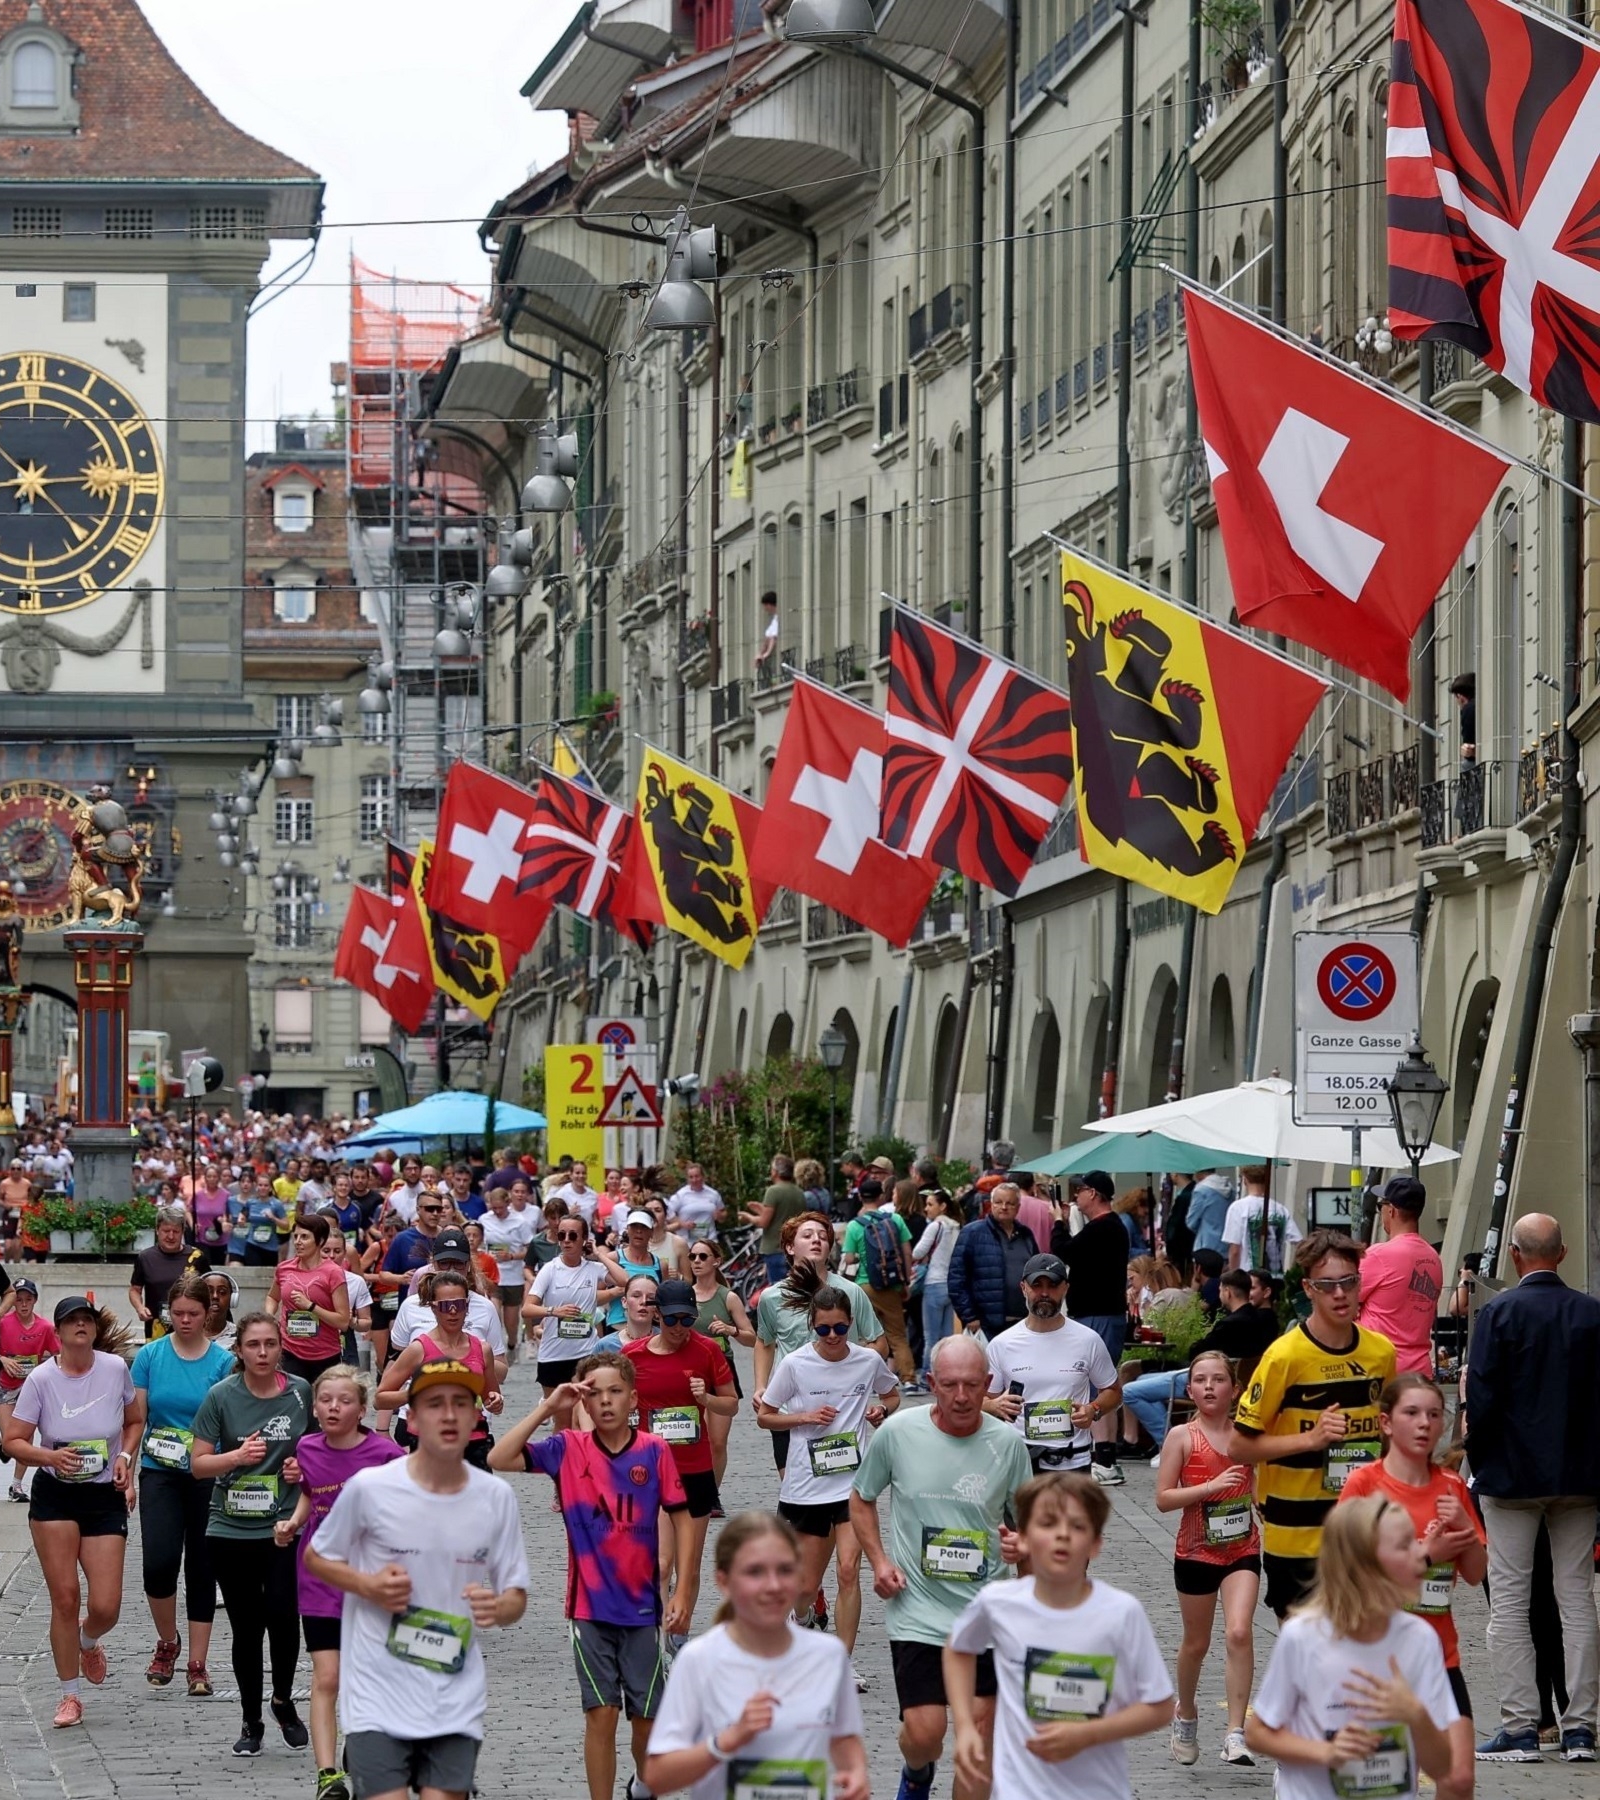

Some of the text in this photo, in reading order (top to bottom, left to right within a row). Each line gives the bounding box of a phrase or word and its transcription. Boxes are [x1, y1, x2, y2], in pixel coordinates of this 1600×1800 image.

[16, 356, 46, 381] XII
[119, 414, 143, 437] II
[1310, 1035, 1401, 1048] Ganze Gasse
[570, 1053, 595, 1094] 2
[1324, 1077, 1388, 1089] 18.05.24
[1334, 1097, 1377, 1110] 12.00
[566, 1104, 599, 1115] Jitz ds
[561, 1120, 585, 1130] Rohr
[1321, 1363, 1345, 1373] CREDIT
[1325, 1372, 1346, 1380] SUISSE
[653, 1412, 675, 1420] CRAFT
[659, 1421, 690, 1431] Jessica
[1300, 1415, 1380, 1435] P500
[157, 1440, 176, 1450] Nora
[812, 1439, 837, 1448] CRAFT
[824, 1448, 848, 1459] Anais
[1329, 1448, 1366, 1457] MIGROS
[232, 1492, 268, 1501] Melanie
[1223, 1515, 1244, 1526] Jara
[940, 1548, 970, 1560] Peter
[1426, 1582, 1450, 1593] Lara
[415, 1631, 444, 1648] Fred
[1056, 1680, 1083, 1696] Nils
